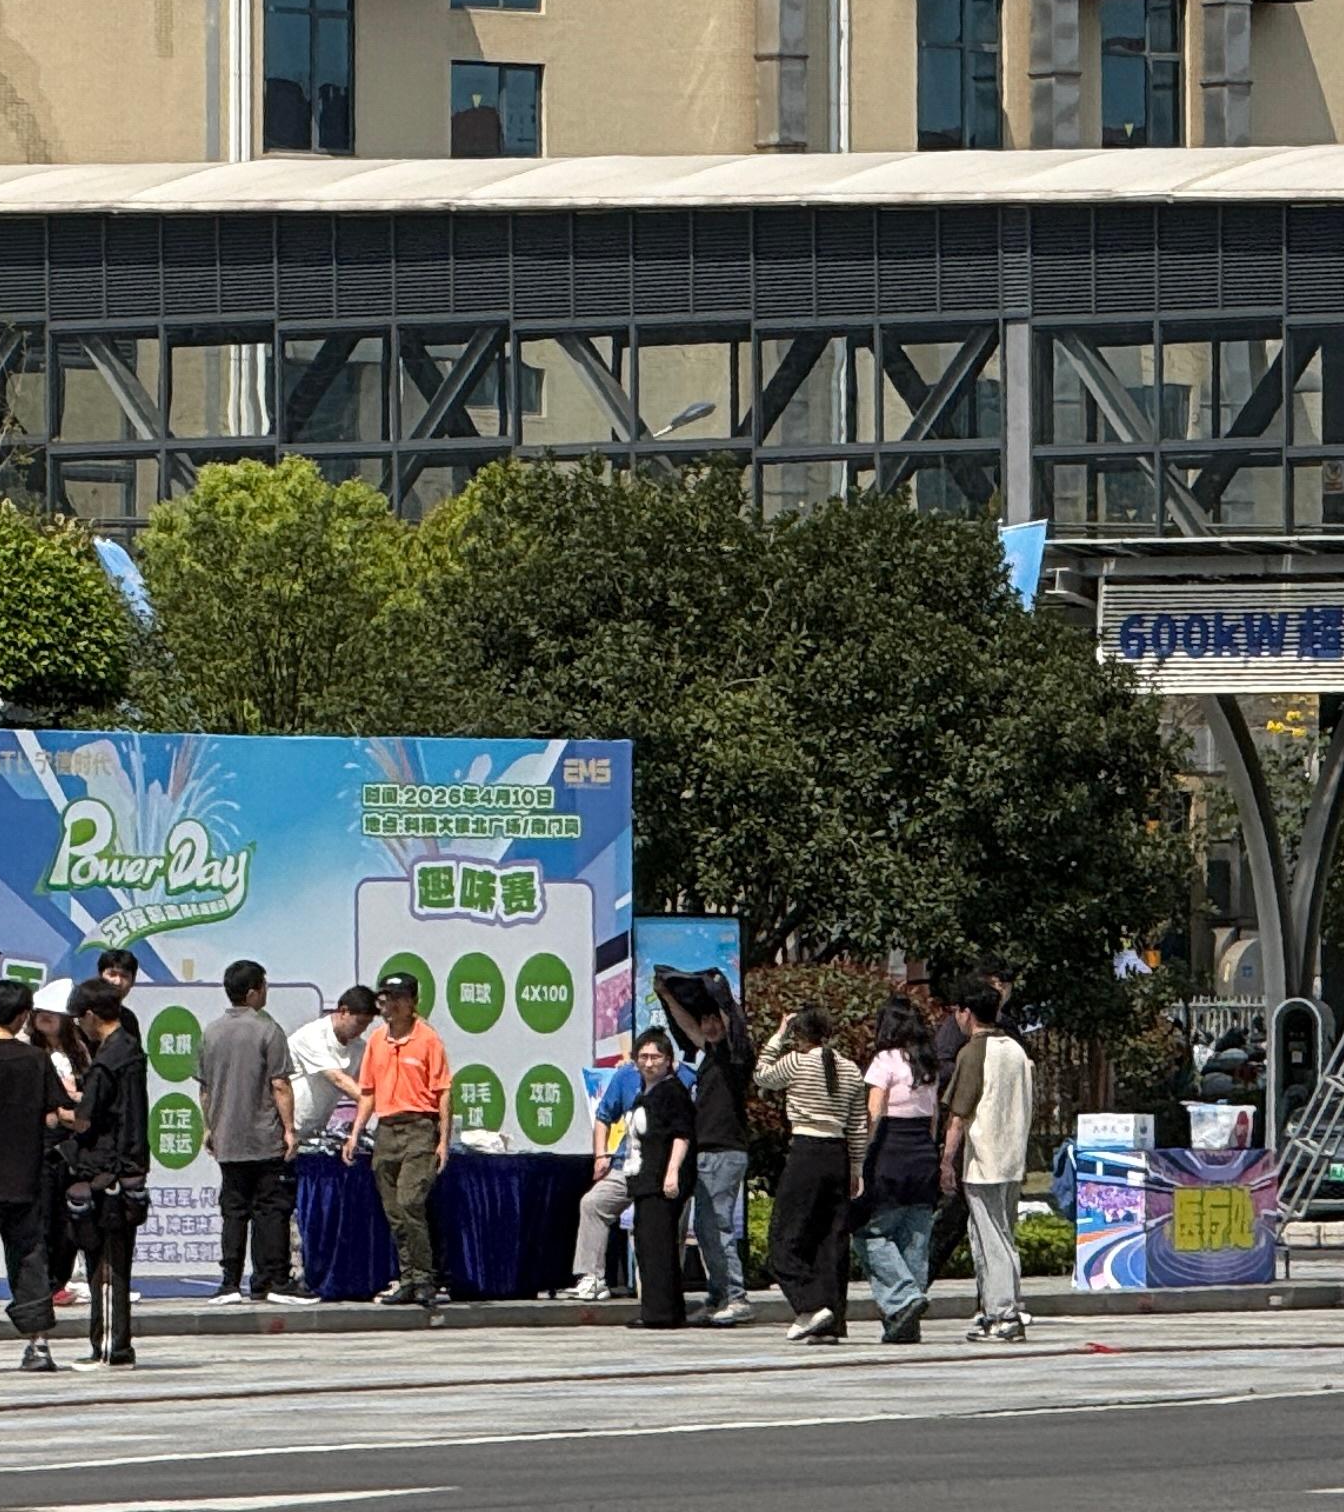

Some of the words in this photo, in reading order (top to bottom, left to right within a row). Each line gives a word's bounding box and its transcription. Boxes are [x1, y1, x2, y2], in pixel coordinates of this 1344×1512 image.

[49, 799, 163, 885] Power
[168, 820, 248, 896] Day
[417, 864, 538, 916] 趣味赛
[521, 985, 568, 1002] 4X100
[460, 1082, 492, 1103] 羽毛
[159, 1108, 193, 1130] 立定
